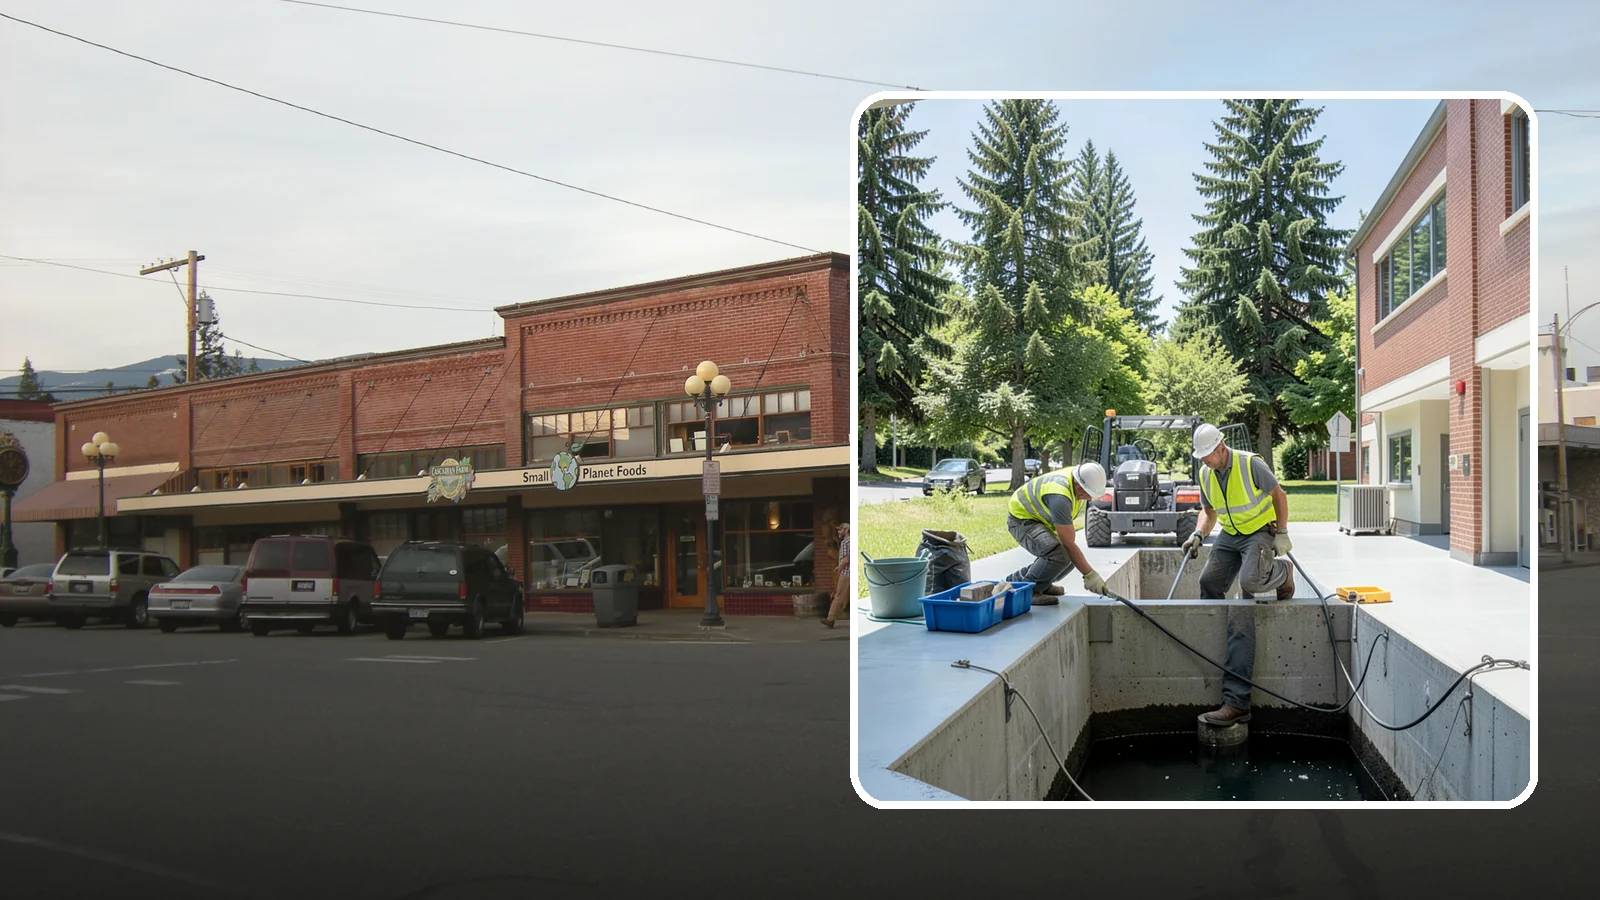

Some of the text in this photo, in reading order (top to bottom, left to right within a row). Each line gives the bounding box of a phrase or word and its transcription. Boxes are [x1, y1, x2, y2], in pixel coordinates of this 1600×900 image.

[523, 464, 647, 483] Small Planet Foods
